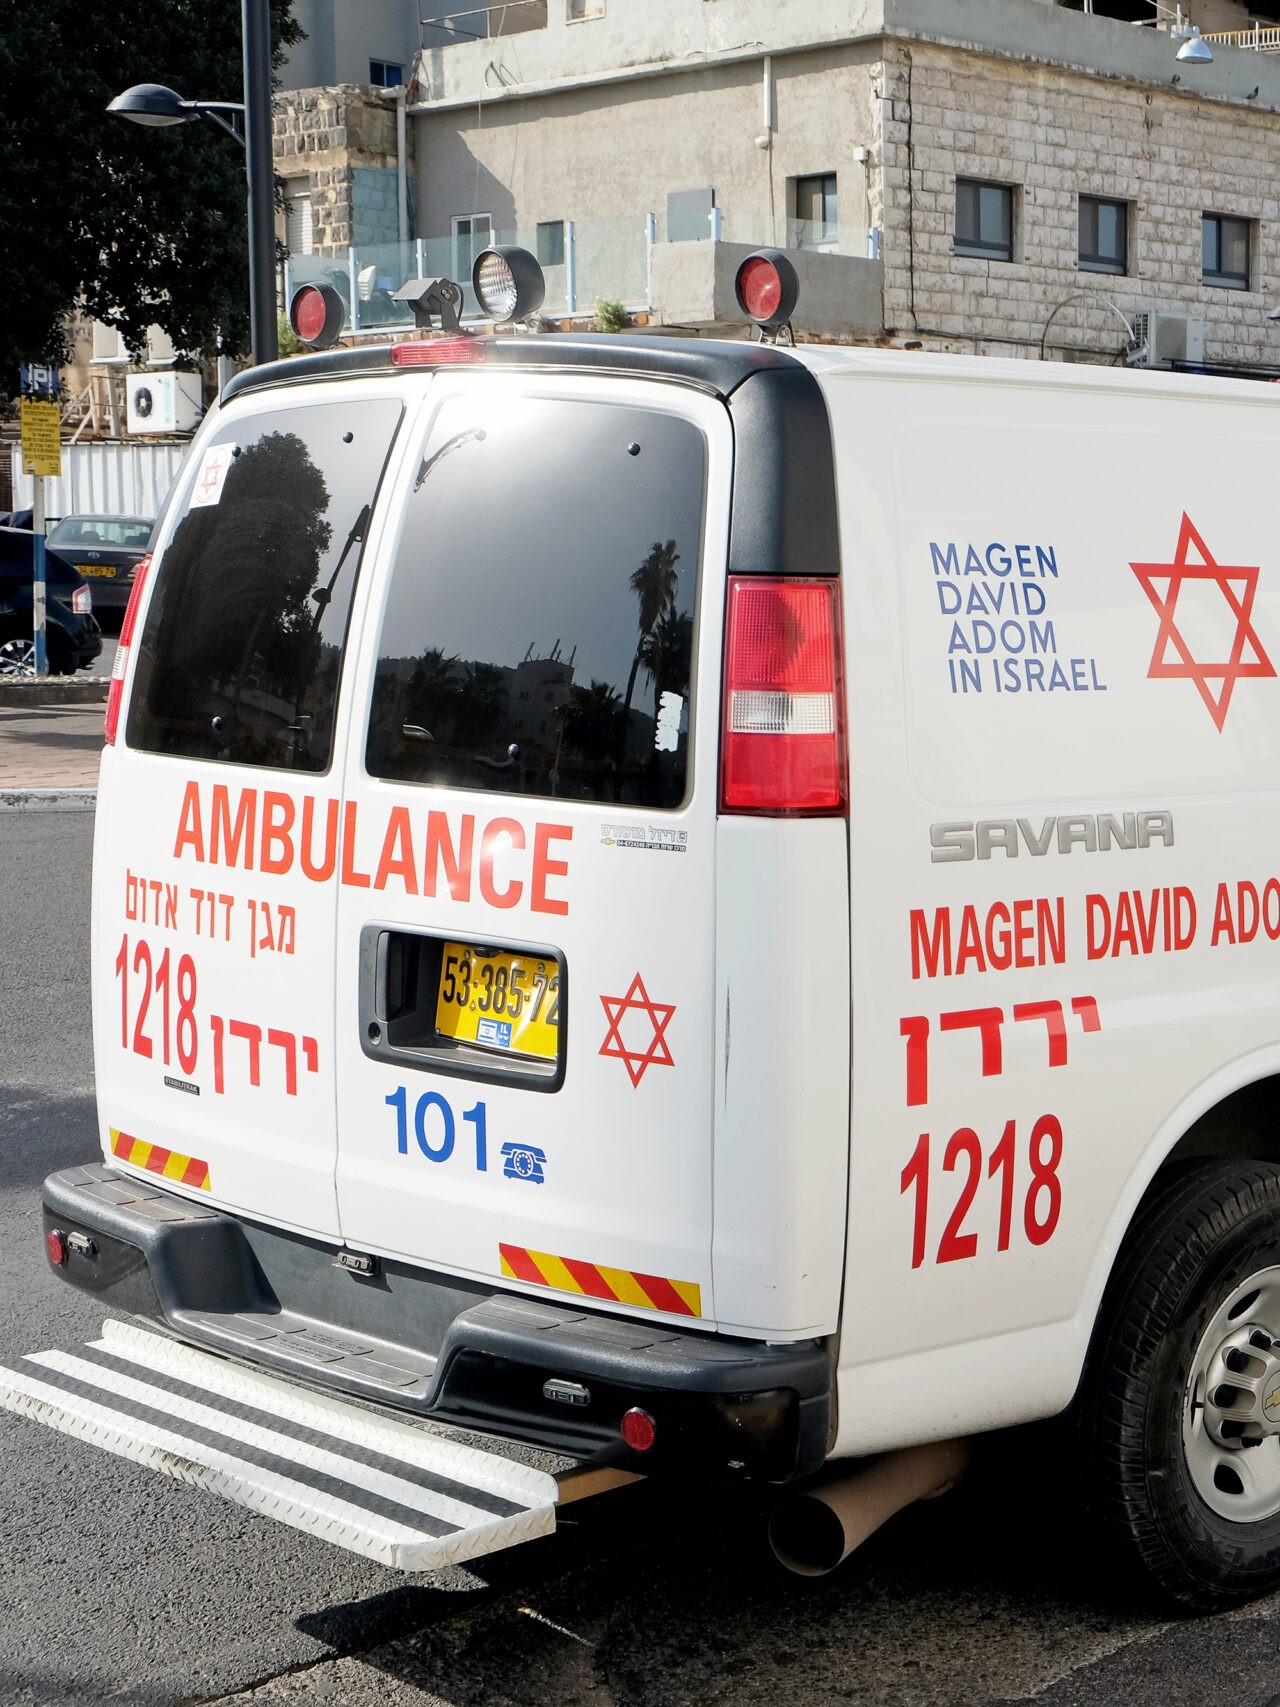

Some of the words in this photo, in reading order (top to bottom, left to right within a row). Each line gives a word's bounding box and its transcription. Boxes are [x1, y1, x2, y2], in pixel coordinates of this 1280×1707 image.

[929, 542, 1059, 578] MAGEN
[938, 580, 1047, 615] DAVID
[948, 619, 1057, 654] ADOM
[948, 658, 983, 693] IN
[993, 657, 1108, 692] ISRAEL
[173, 780, 574, 916] AMBULANCE
[930, 810, 1175, 863] SAVANA
[125, 868, 178, 930] אדום
[190, 889, 235, 942] דוד
[248, 900, 296, 958] מגן
[910, 896, 1066, 980] MAGEN
[1086, 885, 1197, 961] DAVID
[115, 933, 199, 1076] 1218
[210, 1014, 319, 1097] ירדן
[900, 995, 1102, 1107] ירדן
[385, 1086, 488, 1172] 101
[900, 1113, 1064, 1269] 1218
